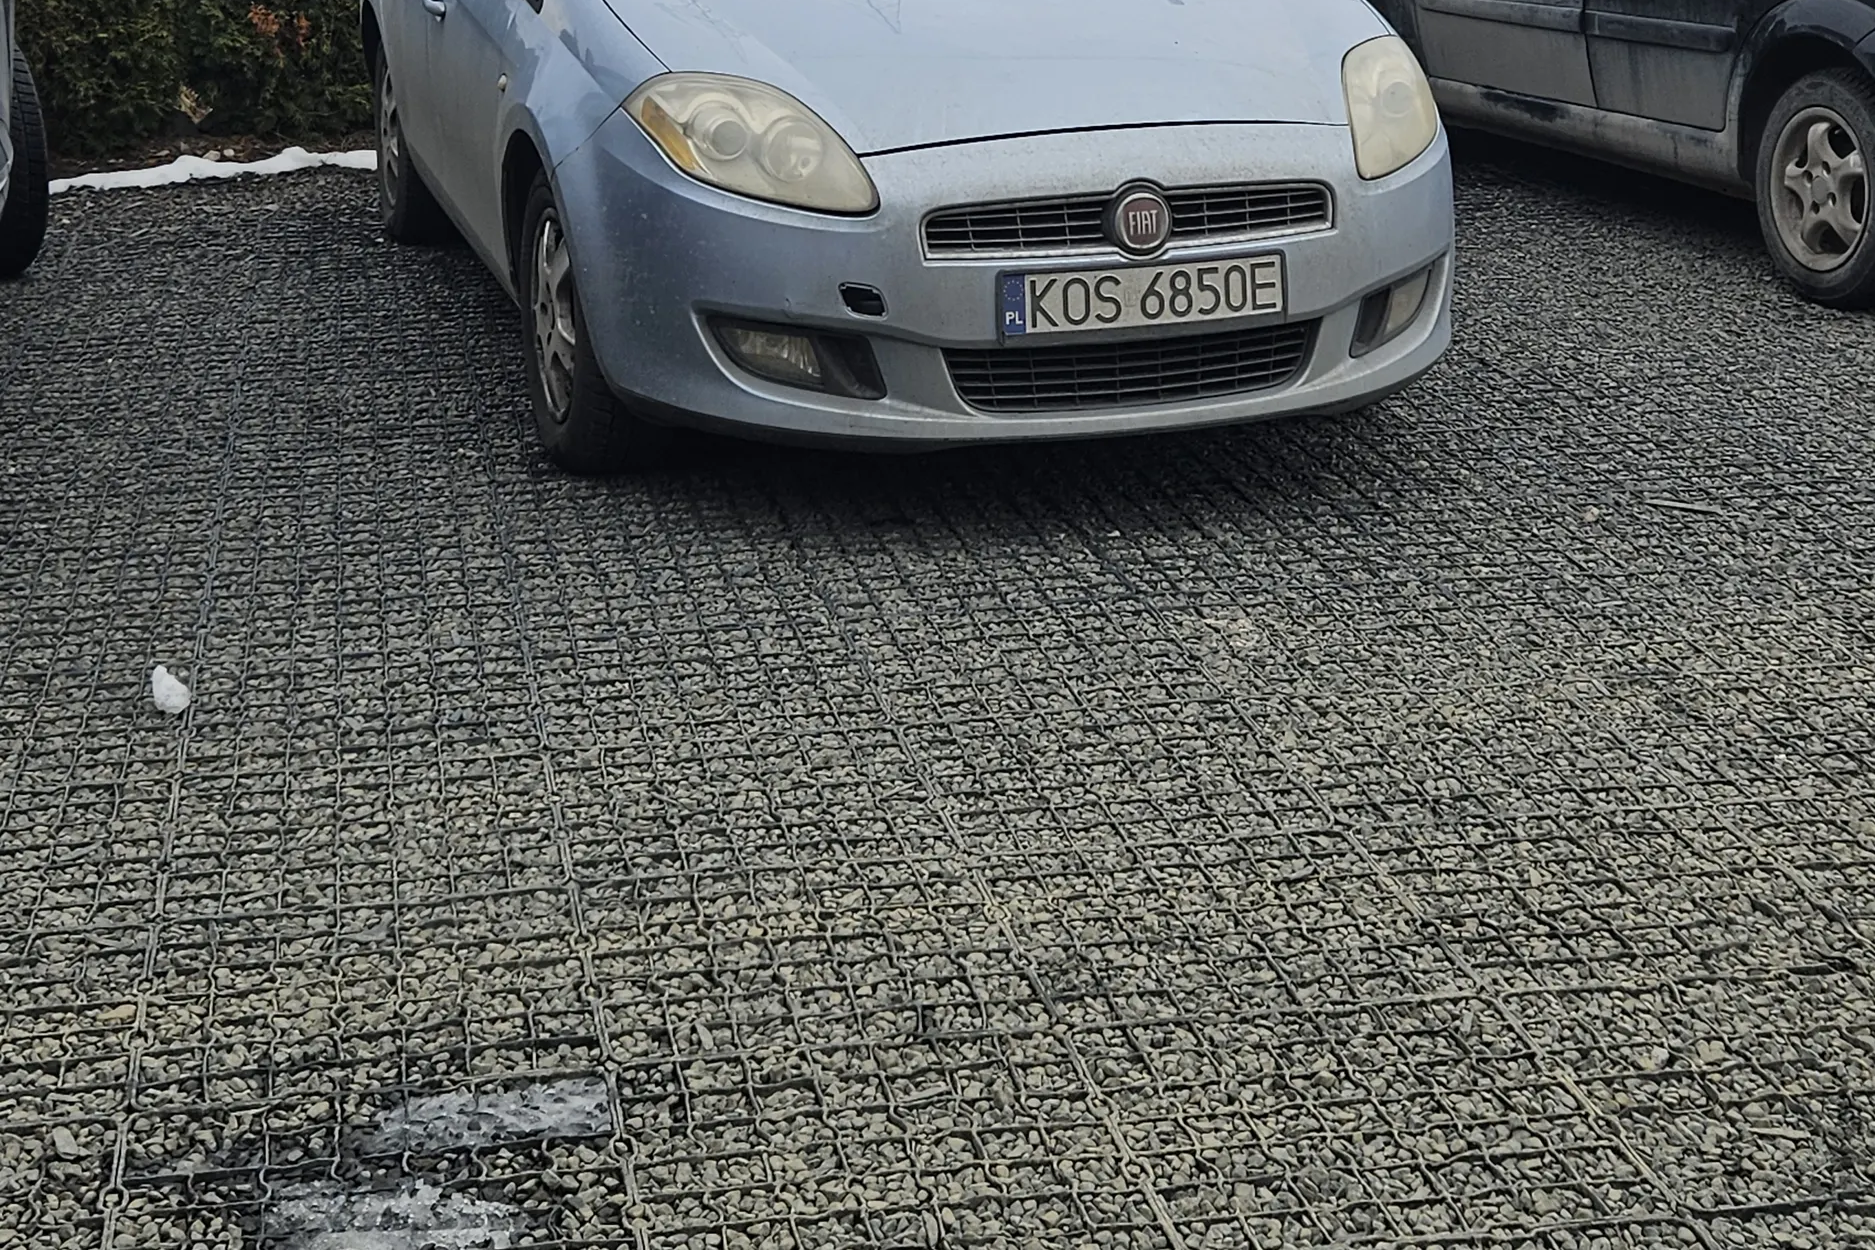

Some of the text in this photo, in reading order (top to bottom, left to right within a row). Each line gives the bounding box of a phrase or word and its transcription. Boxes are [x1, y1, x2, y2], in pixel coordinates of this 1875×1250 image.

[1128, 209, 1159, 236] FIAT
[1030, 261, 1278, 329] KOS 6850E
[1005, 310, 1024, 326] PL
